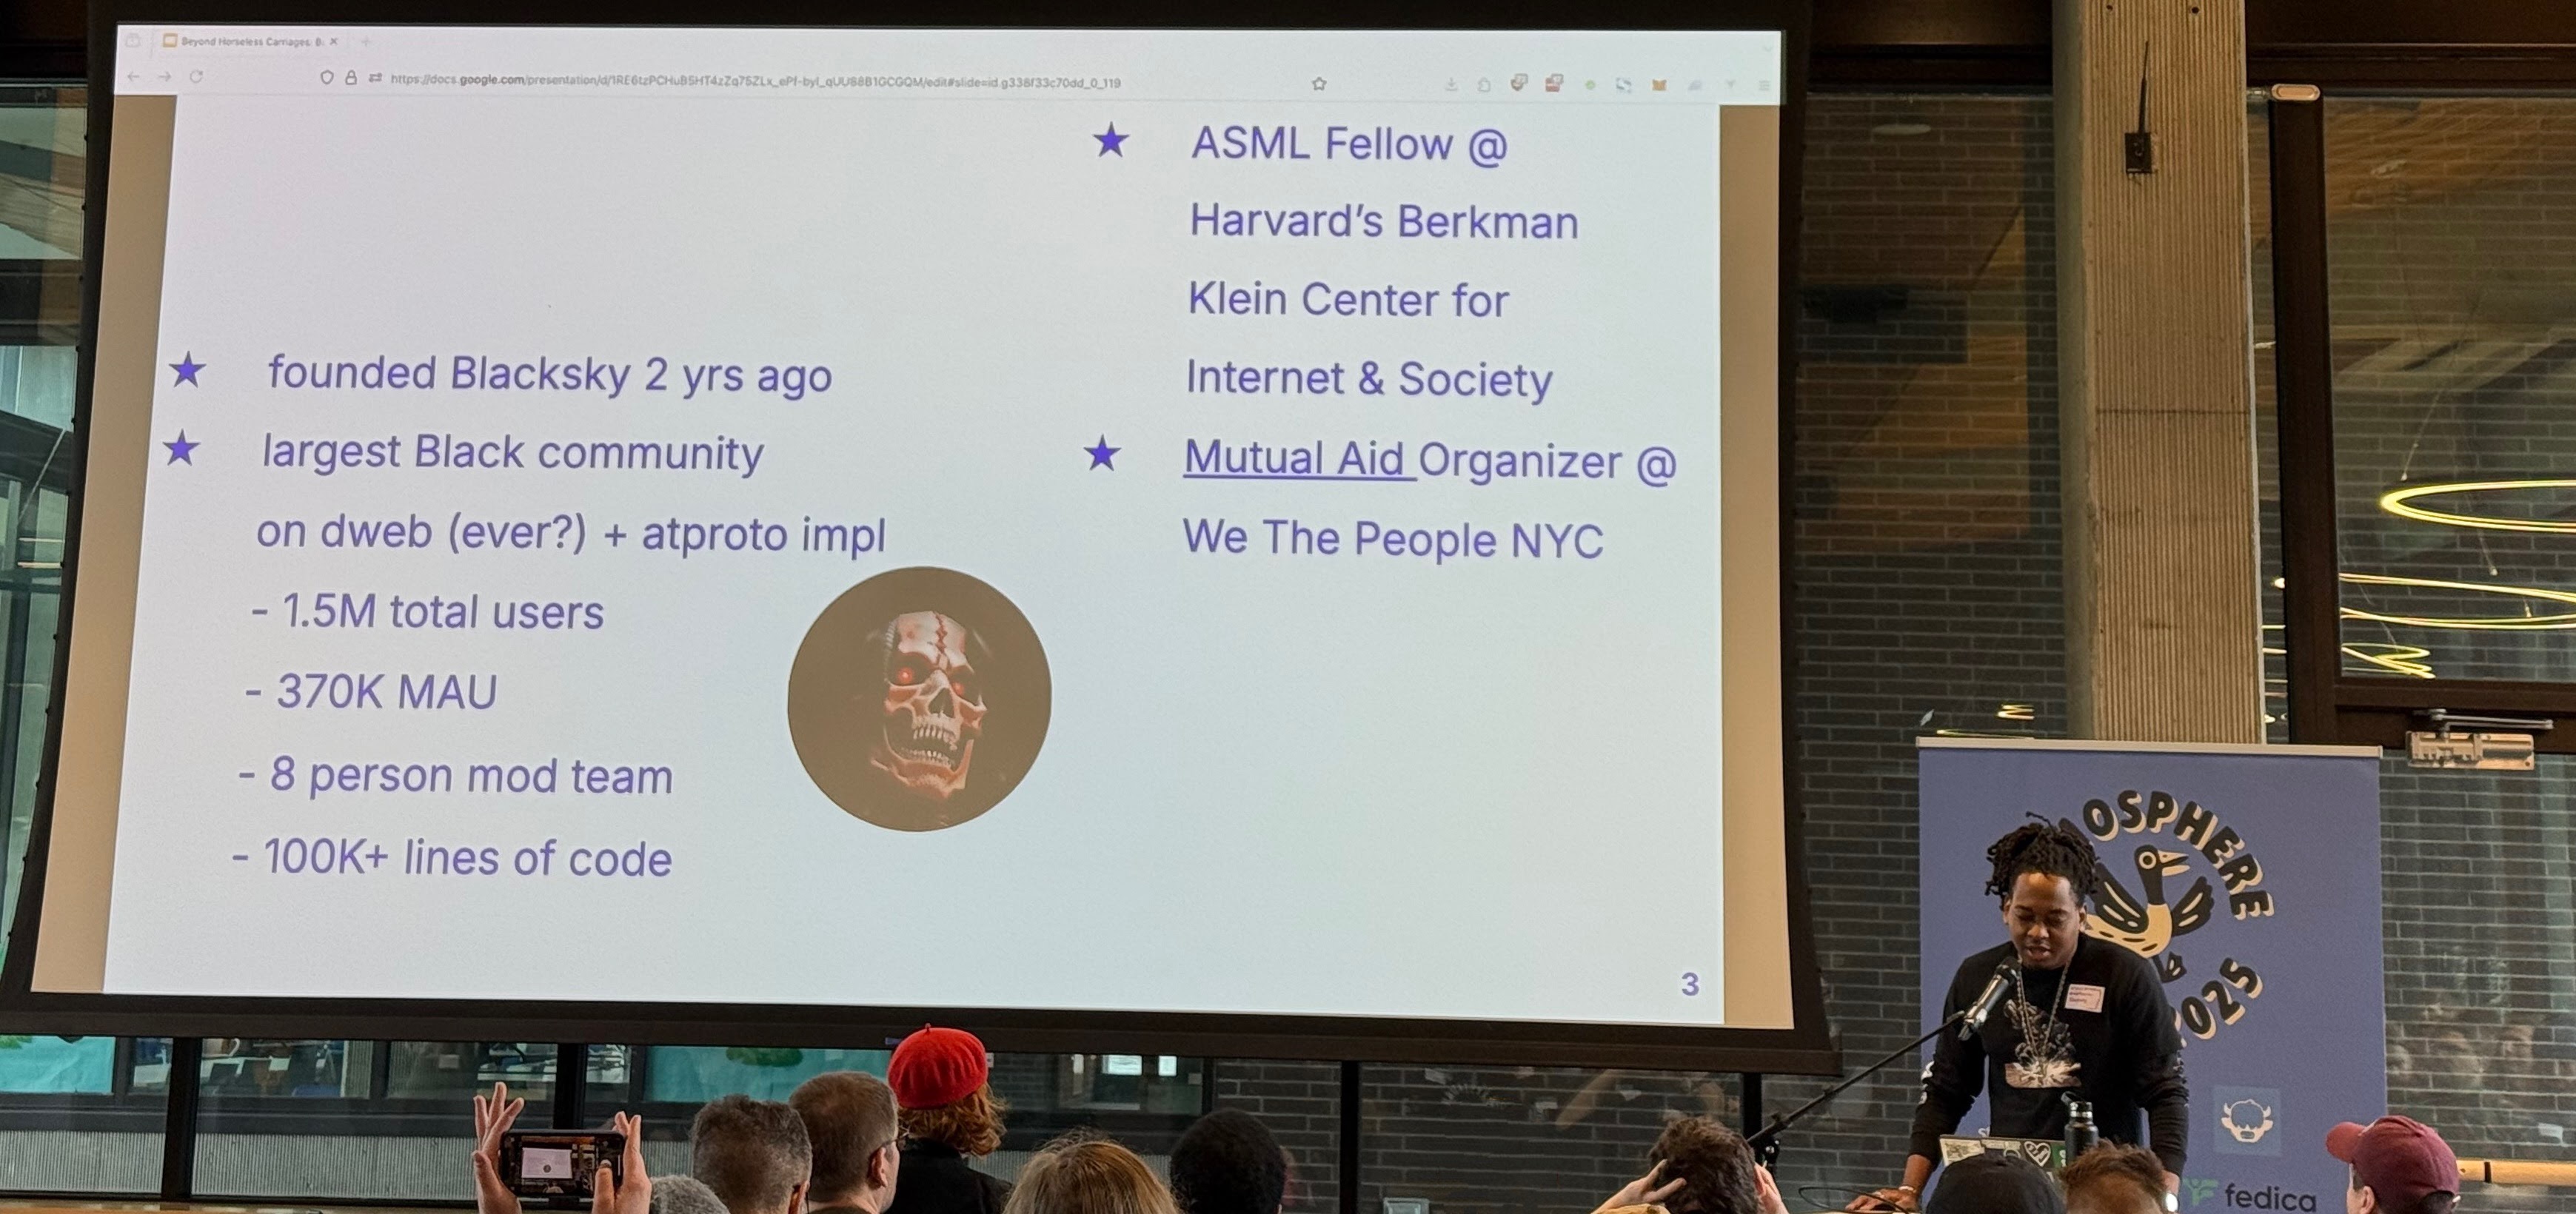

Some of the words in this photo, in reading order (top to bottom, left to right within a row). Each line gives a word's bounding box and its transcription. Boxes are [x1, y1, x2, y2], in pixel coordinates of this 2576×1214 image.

[181, 37, 216, 48] Beyond
[1192, 125, 1311, 160] ASML
[1326, 126, 1454, 161] Fellow
[1469, 128, 1508, 169] @
[1399, 204, 1578, 239] Berkman
[1189, 280, 1286, 315] Klein
[1302, 281, 1440, 317] Center
[1451, 281, 1511, 318] for
[269, 352, 436, 389] founded
[452, 355, 632, 400] Blacksky
[646, 356, 668, 391] 2
[683, 364, 743, 400] yrs
[757, 365, 832, 401] ago
[1188, 358, 1345, 395] Internet
[1358, 360, 1385, 395] &
[1399, 360, 1553, 406] Society
[264, 432, 402, 477] largest
[415, 433, 525, 469] Black
[538, 435, 765, 480] community
[1185, 438, 1324, 477] Mutual
[1337, 440, 1405, 477] Aid
[1419, 442, 1623, 486] Organizer
[1637, 446, 1677, 488] @
[257, 520, 306, 547] on
[321, 513, 432, 549] dweb
[449, 512, 586, 556] (ever?)
[604, 523, 627, 548] +
[643, 517, 788, 560] atproto
[803, 515, 886, 560] impl
[1182, 517, 1248, 554] We
[1262, 519, 1340, 555] The
[1356, 520, 1496, 566] People
[1513, 523, 1604, 560] NYC
[284, 592, 376, 628] 1.5M
[389, 593, 478, 629] total
[494, 602, 604, 630] users
[277, 672, 386, 709] 370K
[398, 674, 497, 710] MAU
[271, 755, 295, 791] 8
[310, 763, 452, 801] person
[468, 757, 558, 794] mod
[571, 759, 672, 794] team
[265, 837, 389, 874] 100K+
[405, 837, 500, 876] lines
[514, 838, 558, 876] of
[569, 840, 672, 877] code
[1682, 972, 1700, 996] 3
[2172, 956, 2264, 1047] 025
[2224, 1182, 2318, 1213] fedica
